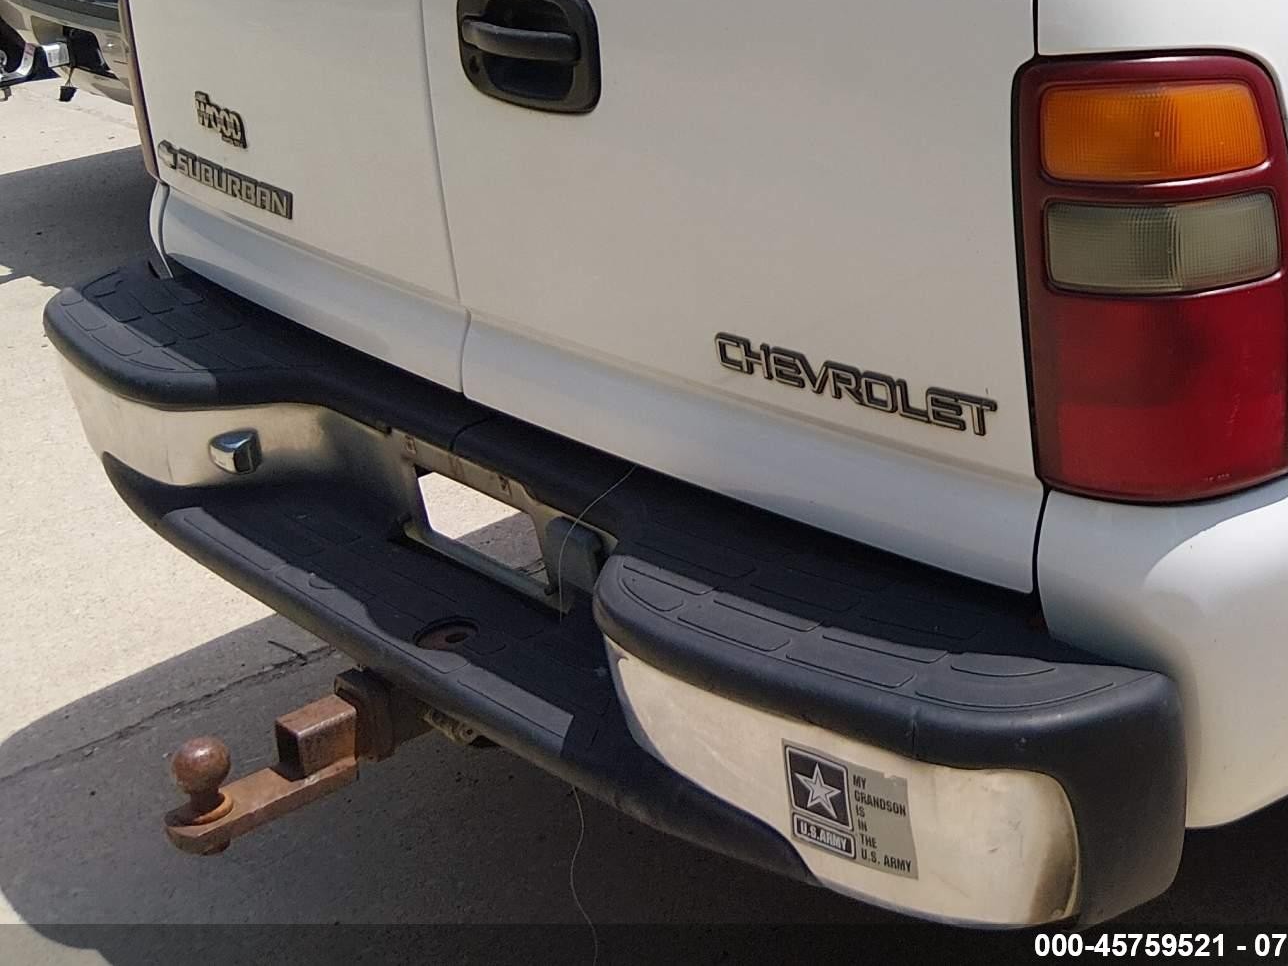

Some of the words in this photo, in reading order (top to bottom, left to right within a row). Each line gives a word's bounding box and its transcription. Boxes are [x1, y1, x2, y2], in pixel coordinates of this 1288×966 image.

[175, 147, 293, 220] SUBURBAN
[713, 331, 998, 437] CHEVROLET
[852, 774, 867, 790] MY
[853, 790, 907, 817] GRANDSON
[855, 805, 865, 818] IS
[857, 818, 868, 832] IN
[860, 834, 878, 849] THE
[861, 848, 881, 865] U.S.
[883, 857, 912, 873] ARMY
